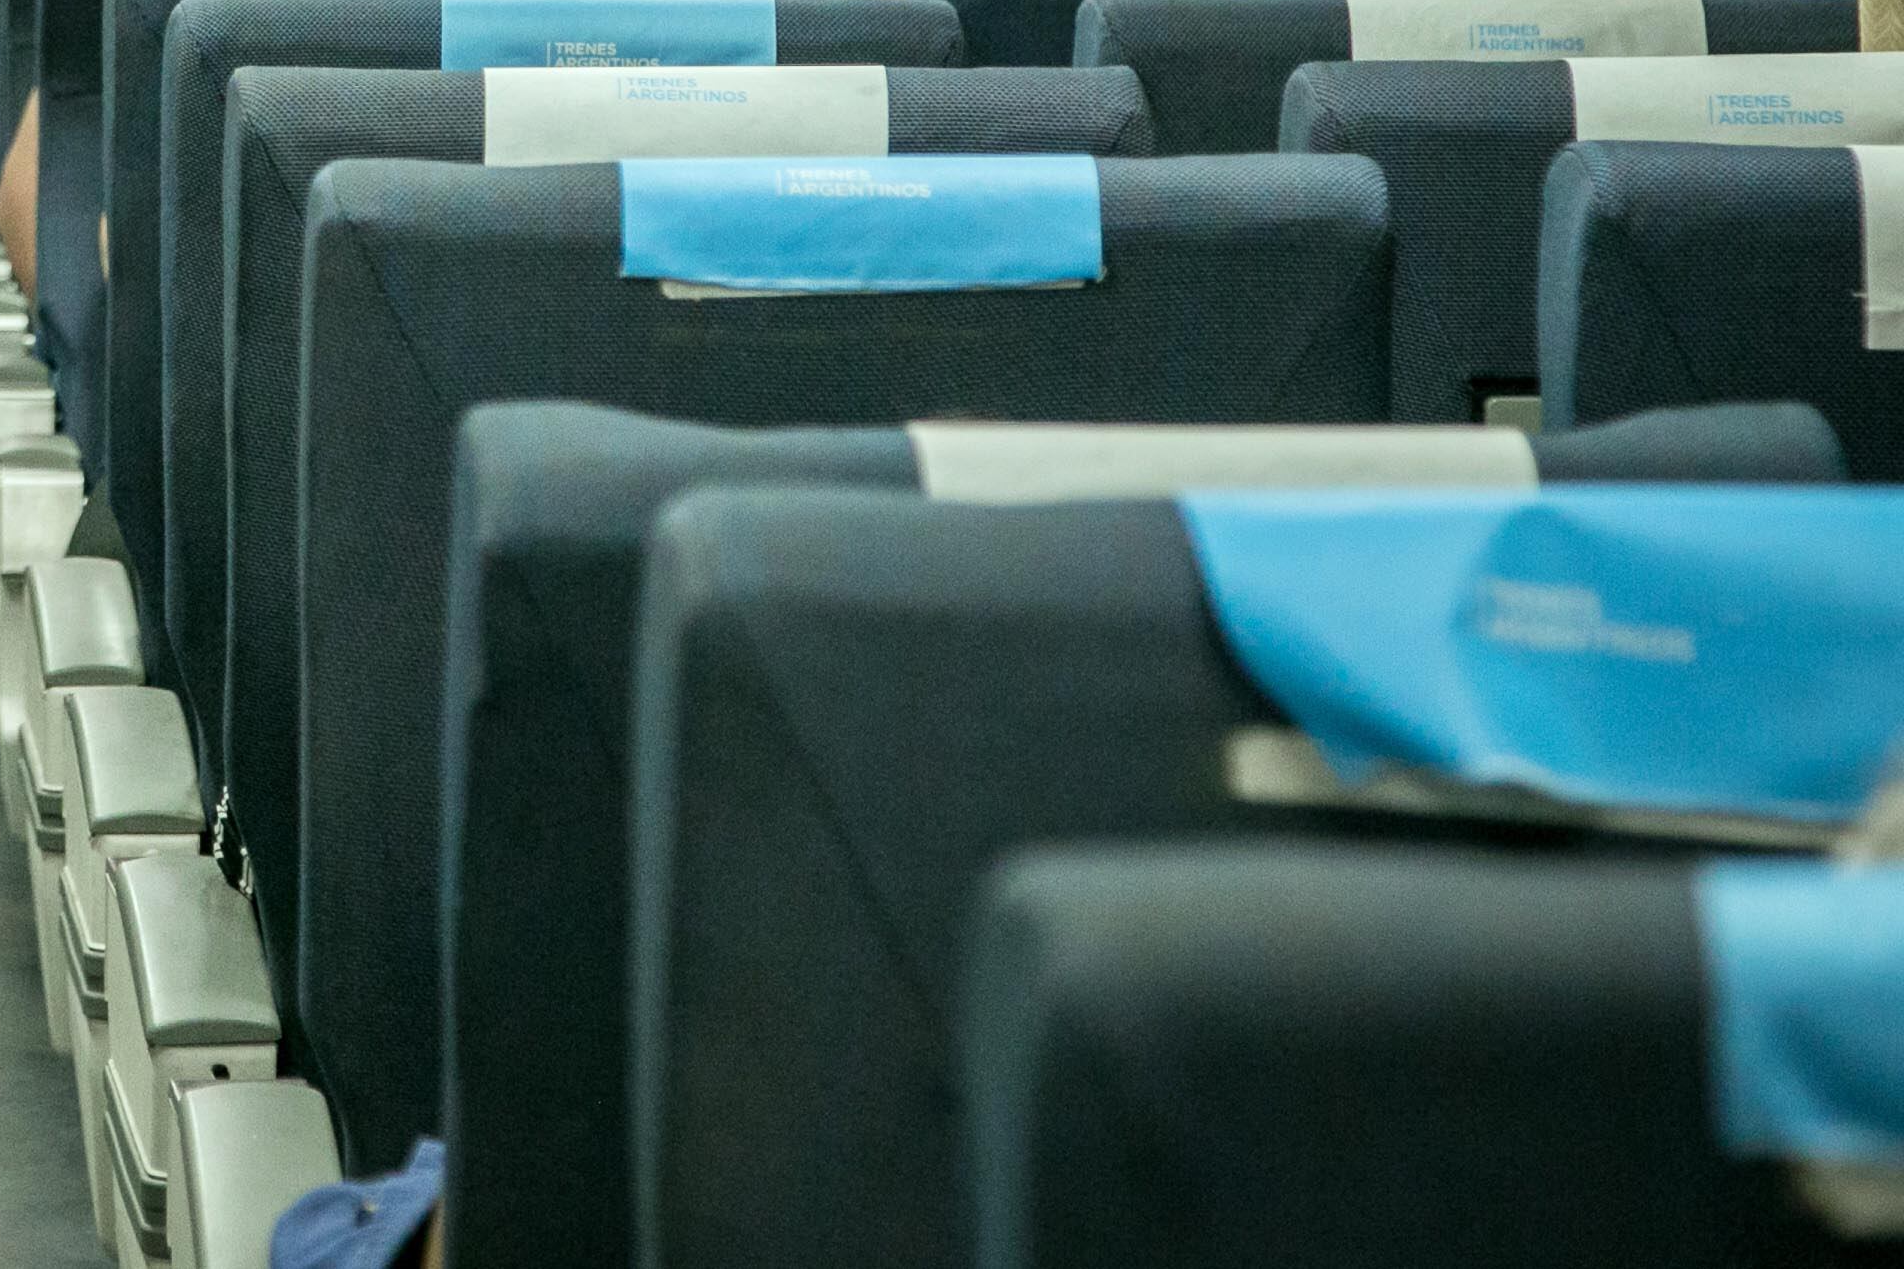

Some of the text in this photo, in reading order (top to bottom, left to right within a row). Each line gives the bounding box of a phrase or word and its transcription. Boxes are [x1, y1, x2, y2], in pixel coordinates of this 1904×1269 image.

[1478, 25, 1540, 36] TRENES
[555, 42, 617, 56] TRENES
[1479, 38, 1585, 51] ARGENTINOS
[555, 57, 661, 67] ARGENTINOS
[626, 77, 697, 87] TRENES
[626, 89, 748, 103] ARGENTINOS
[1717, 95, 1791, 107] TRENES
[1718, 111, 1845, 125] ARGENTINOS
[786, 168, 872, 181] TRENES
[787, 182, 932, 198] ARGENTINOS
